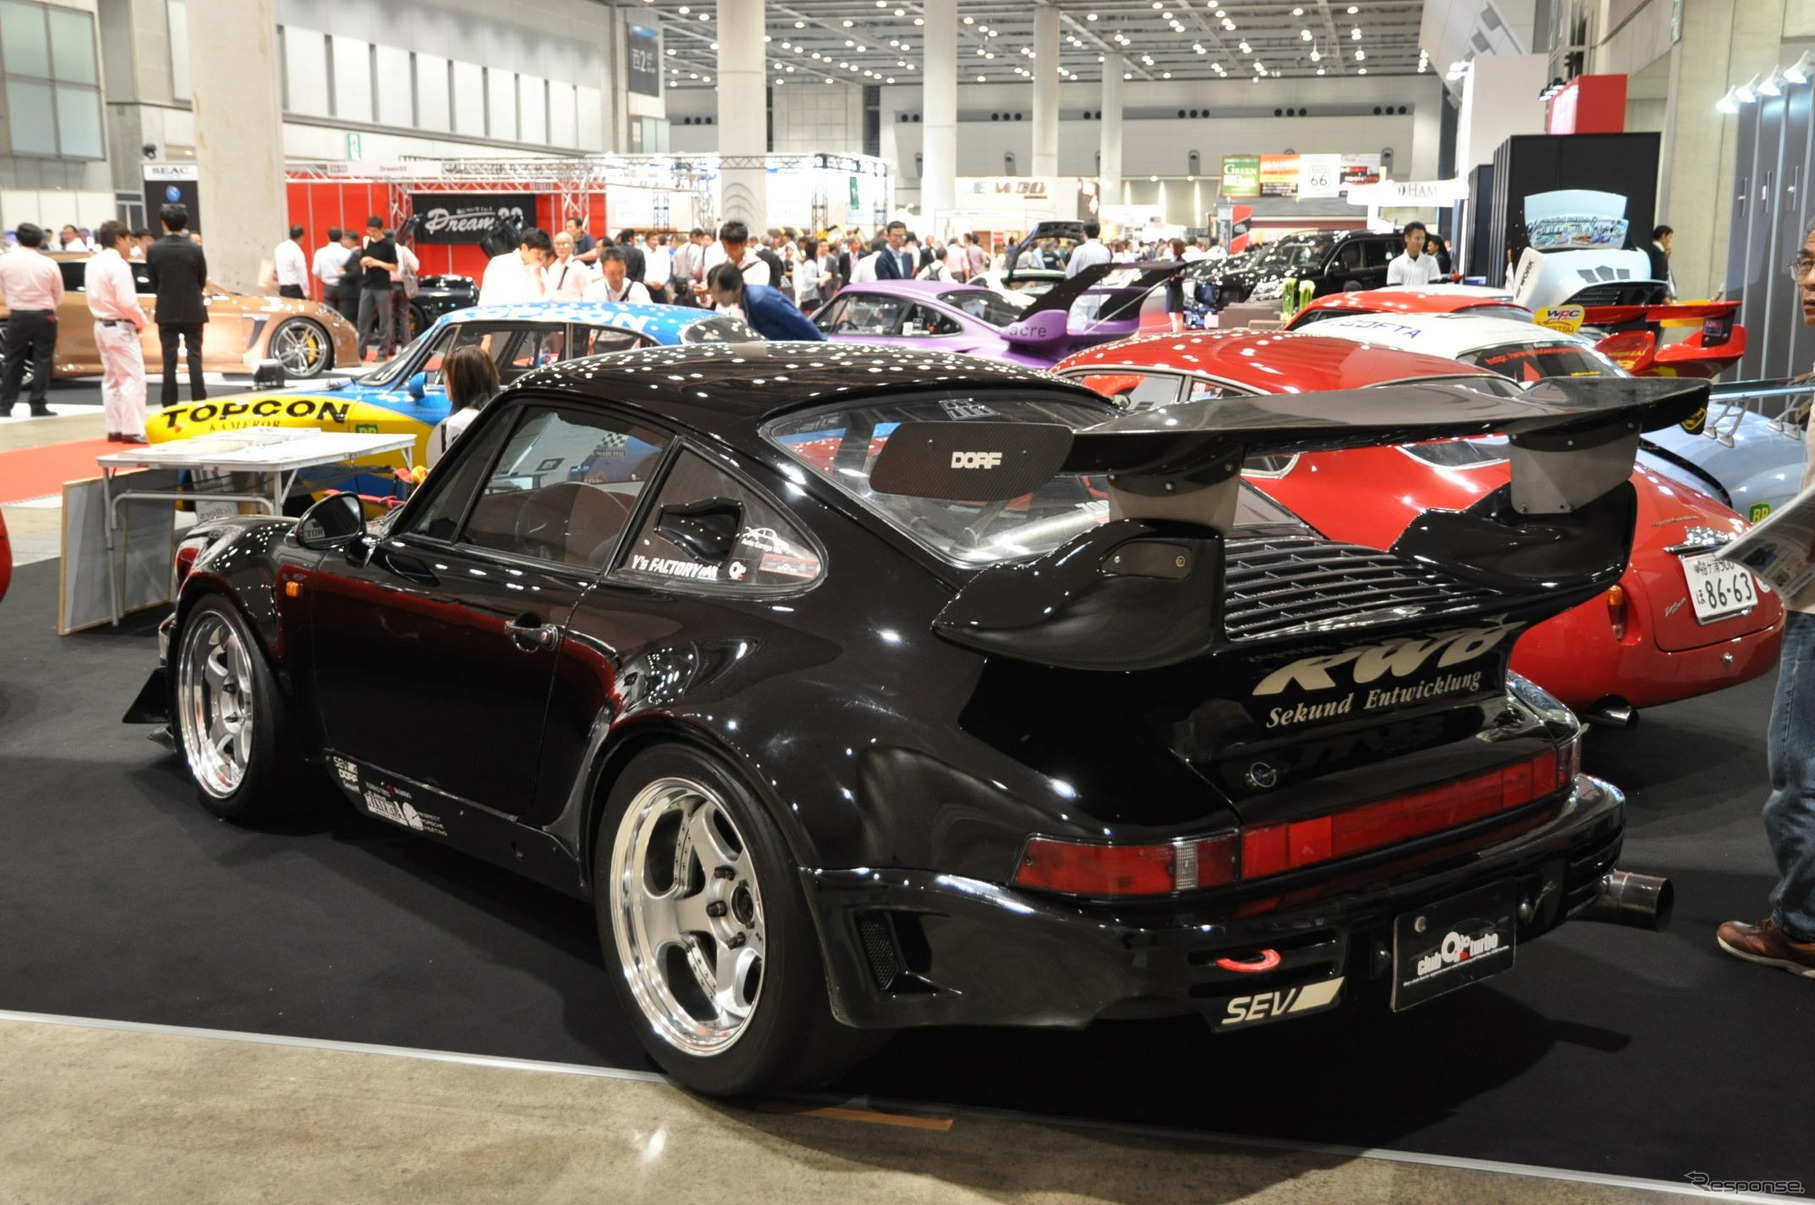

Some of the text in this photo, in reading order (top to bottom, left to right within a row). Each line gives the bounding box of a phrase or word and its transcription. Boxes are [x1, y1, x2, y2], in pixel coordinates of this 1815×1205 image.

[1310, 174, 1328, 186] 66
[1008, 326, 1047, 338] acre
[163, 400, 350, 428] TOPCON
[951, 451, 1003, 470] DORF
[648, 557, 703, 578] FACTORY
[1705, 572, 1752, 609] 86-63
[1266, 671, 1482, 728] Sekund Entwicklung
[1417, 952, 1442, 976] club
[1469, 933, 1499, 957] turbo
[1221, 988, 1297, 1024] SEV
